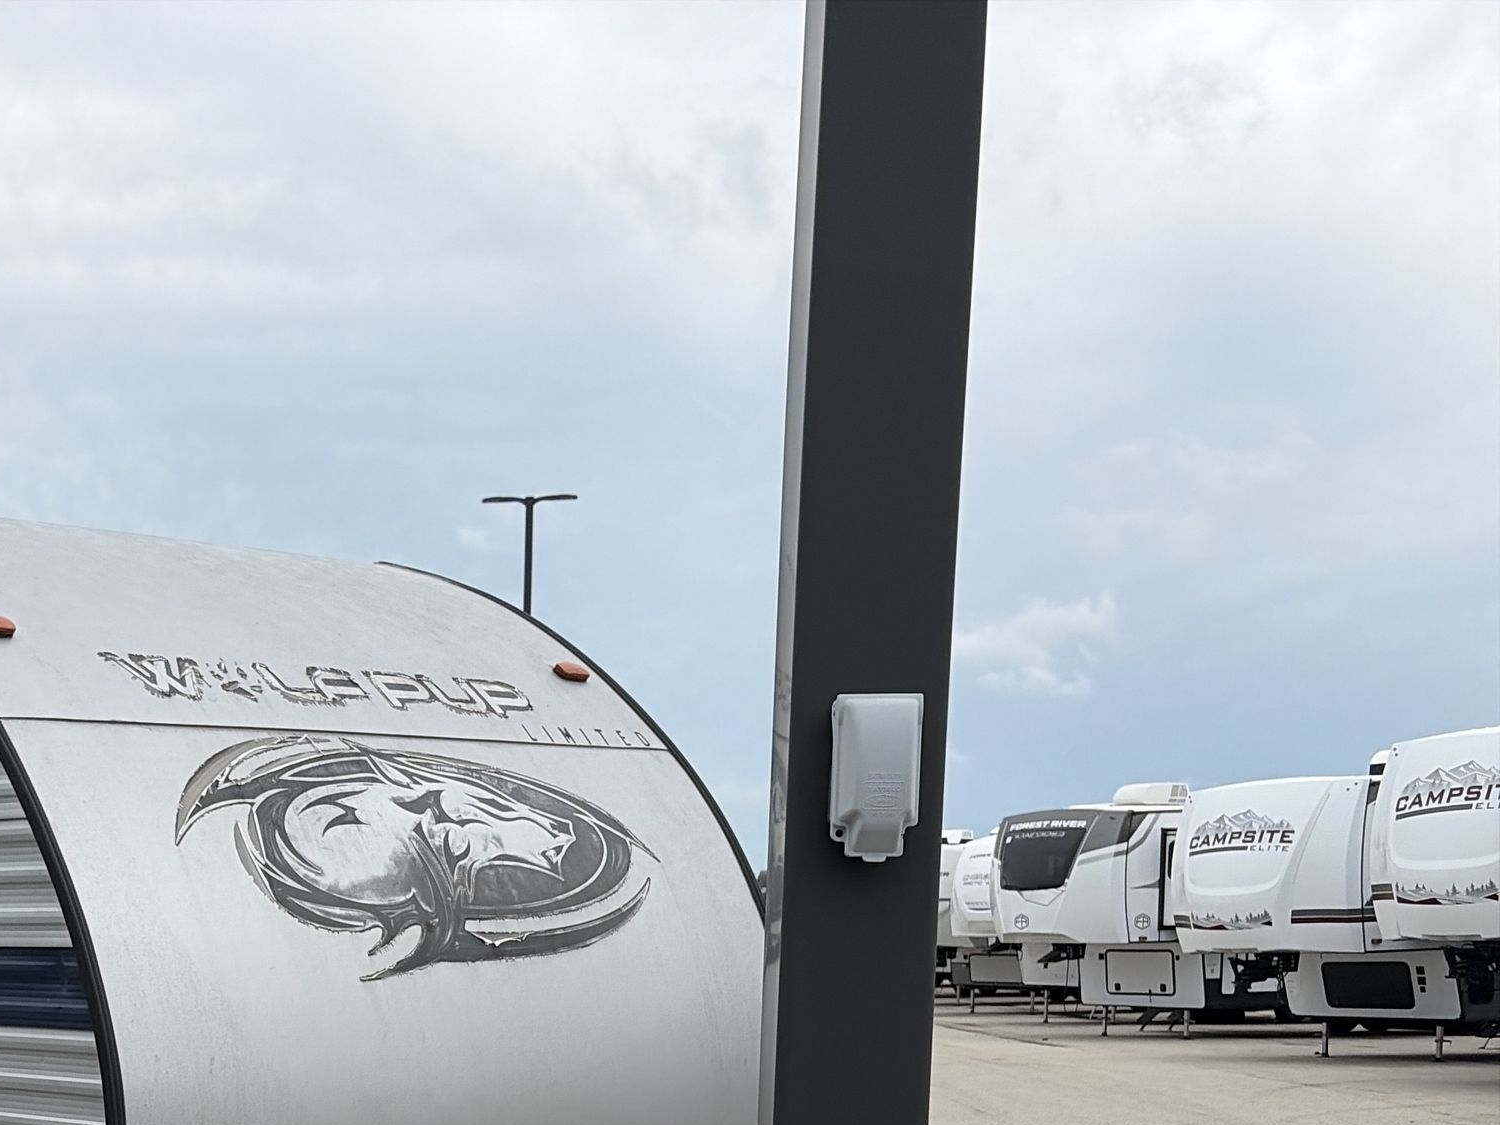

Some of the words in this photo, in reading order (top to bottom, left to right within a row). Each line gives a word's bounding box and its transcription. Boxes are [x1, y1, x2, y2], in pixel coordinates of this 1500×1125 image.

[521, 723, 651, 747] LIMITED
[1395, 783, 1500, 813] CAMPSI
[1009, 820, 1050, 832] FOREST
[1050, 819, 1087, 829] RIVER
[1189, 829, 1295, 850] CAMPSITE
